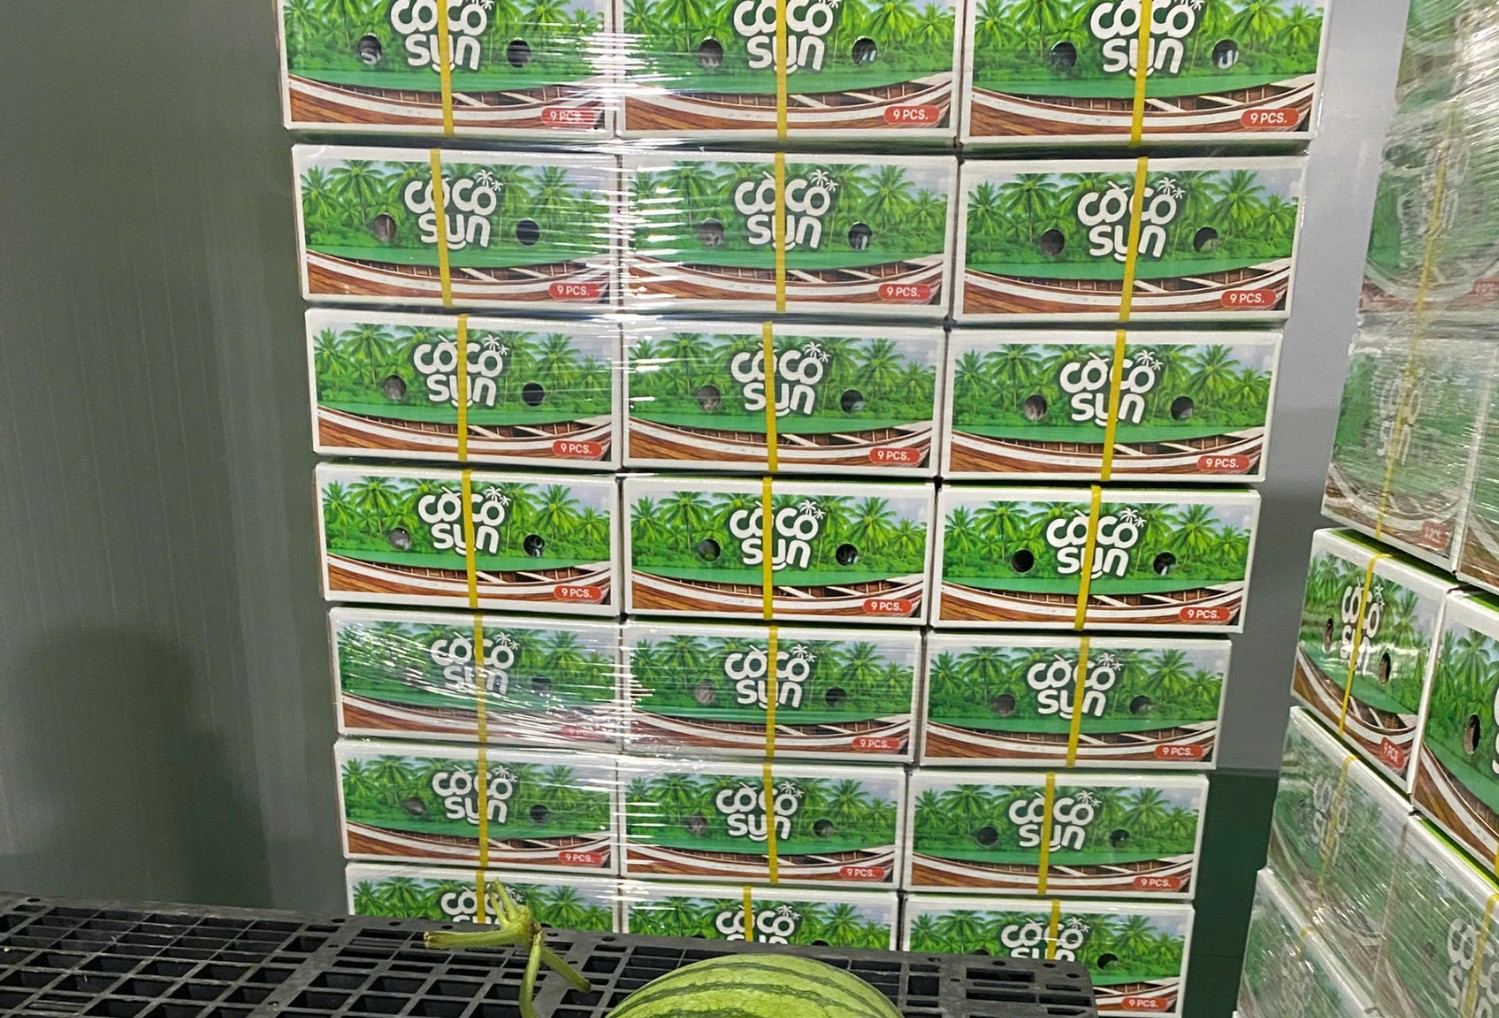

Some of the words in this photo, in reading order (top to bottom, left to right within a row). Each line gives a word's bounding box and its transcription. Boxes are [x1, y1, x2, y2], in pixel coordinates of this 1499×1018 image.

[893, 110, 900, 120] 9
[903, 109, 928, 120] PCS.
[1250, 113, 1258, 123] 9
[1260, 113, 1287, 123] PCS.
[557, 286, 564, 295] 9
[566, 286, 589, 296] PCS.
[887, 287, 893, 297] 9
[896, 287, 920, 297] PCS.
[1230, 293, 1237, 303] 9
[1239, 293, 1264, 303] PCS.
[561, 444, 567, 452] 9
[569, 444, 592, 454] PCS.
[878, 451, 884, 460] 9
[886, 451, 910, 460] PCS.
[1205, 458, 1213, 467] 9
[1214, 459, 1239, 468] PCS.
[561, 588, 568, 597] 9
[569, 589, 592, 598] PCS.
[871, 602, 878, 610] 9
[879, 602, 903, 611] PCS.
[1188, 610, 1194, 618] 9
[1196, 610, 1220, 619] PCS.
[869, 740, 890, 748] PCS.
[1162, 747, 1169, 755] 9
[1171, 748, 1194, 756] PCS.
[573, 854, 594, 862] PCS.
[854, 869, 875, 877] PCS.
[1150, 879, 1171, 887] PCS.
